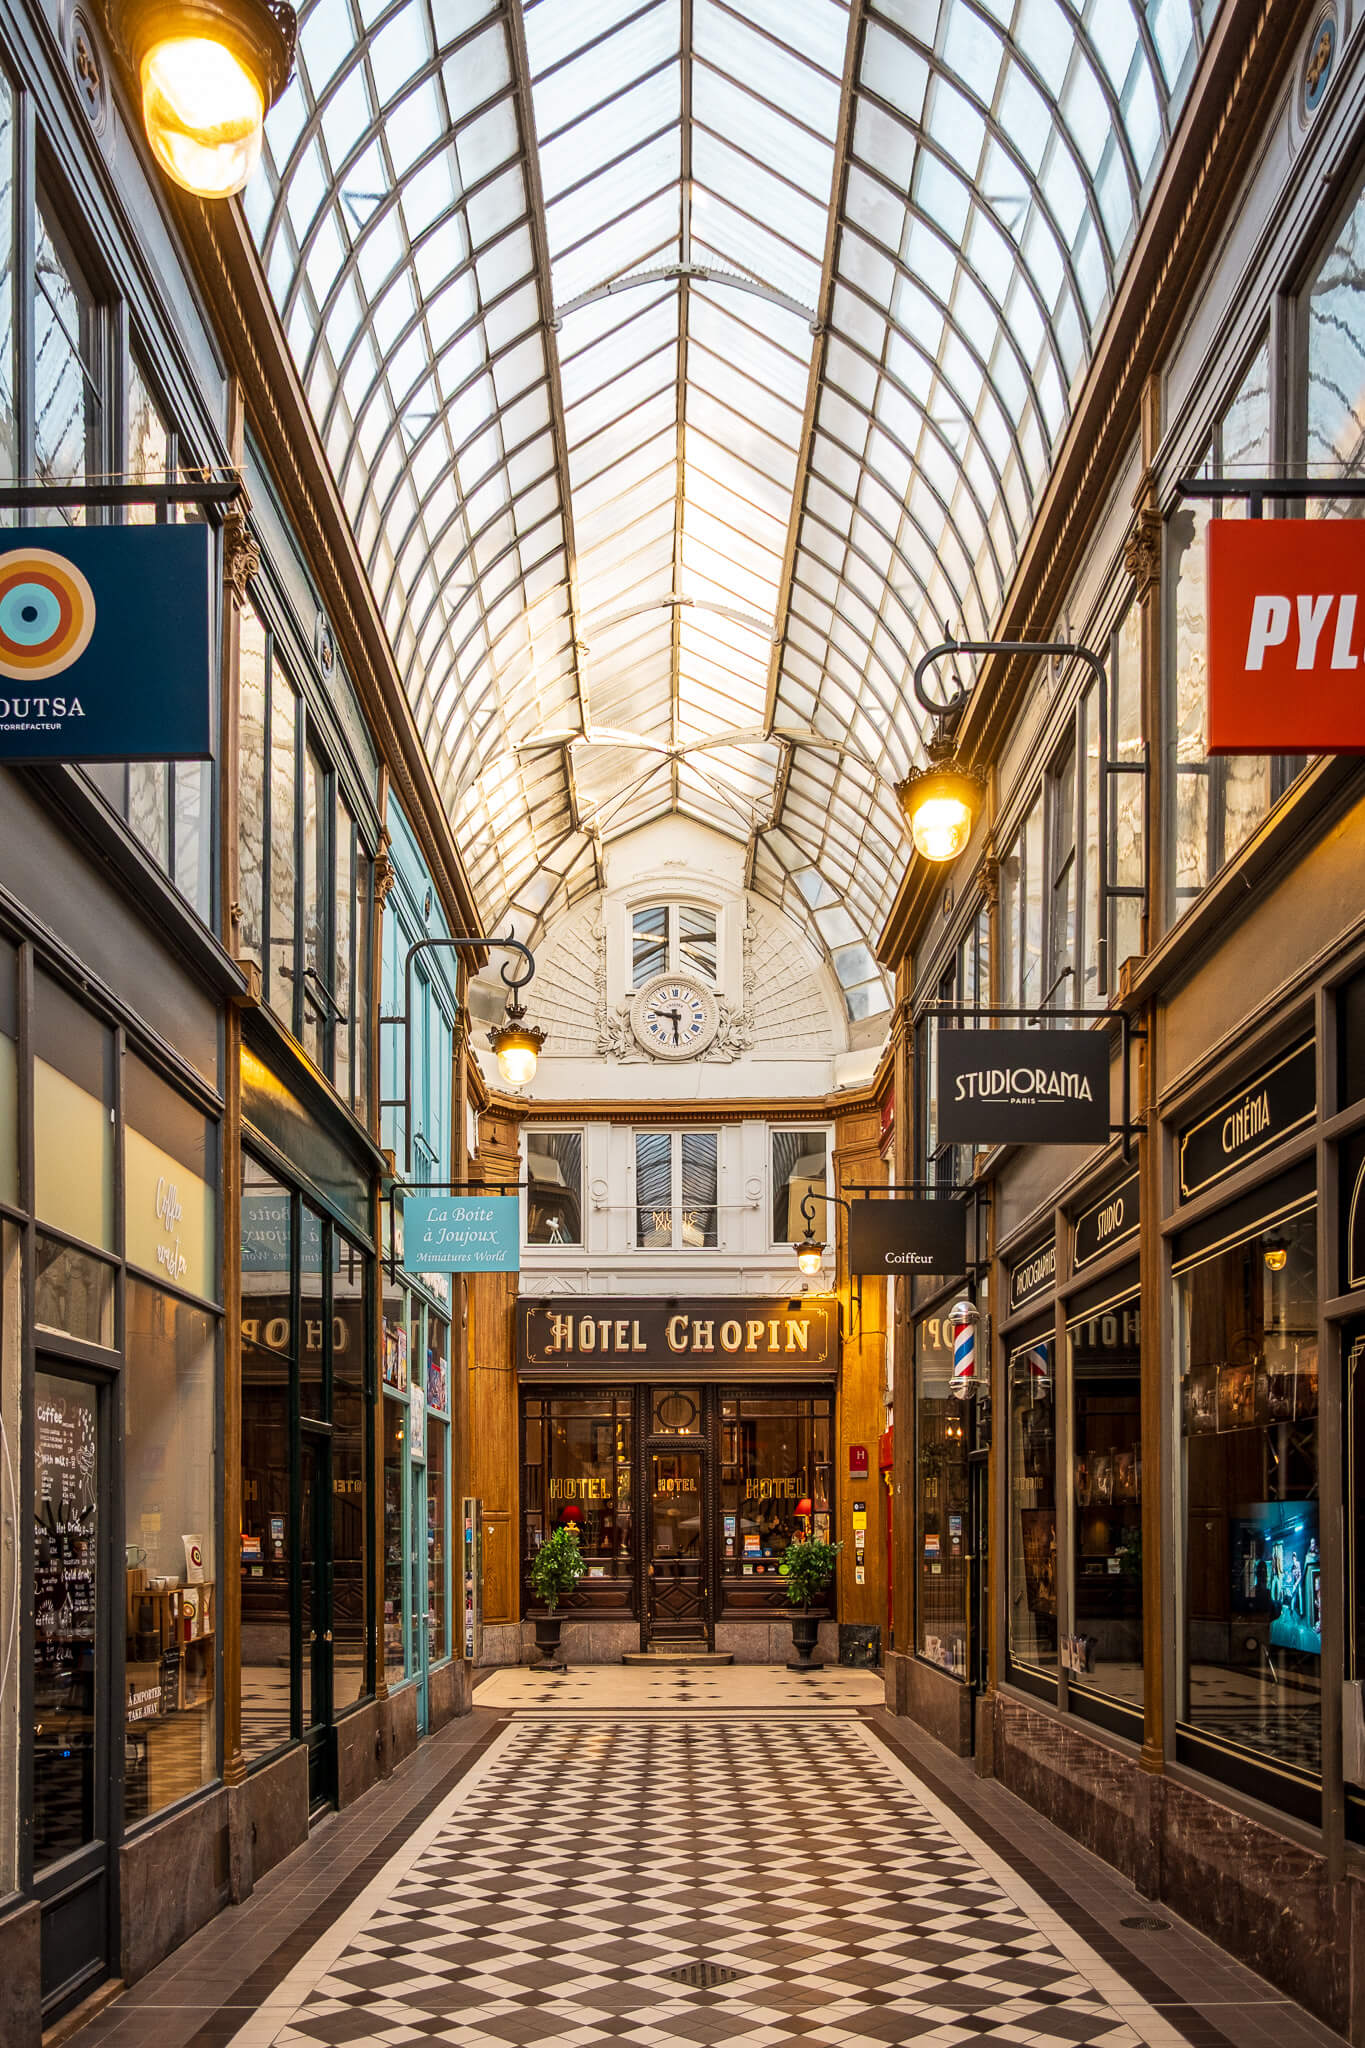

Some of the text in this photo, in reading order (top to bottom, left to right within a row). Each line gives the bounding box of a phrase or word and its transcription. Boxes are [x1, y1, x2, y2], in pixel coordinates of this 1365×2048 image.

[1245, 595, 1365, 670] PYL
[0, 722, 62, 731] TORRÉFACTEUR
[954, 1068, 1094, 1102] STUDIORAMA
[1222, 1089, 1270, 1153] CINÉMA
[424, 1207, 447, 1222] La
[1097, 1198, 1124, 1241] STUDIO
[423, 1226, 500, 1247] à Joujoux
[416, 1250, 508, 1262] Miniatures World
[885, 1252, 933, 1264] Coiffeur
[545, 1311, 647, 1354] HÔTEL
[37, 1406, 63, 1424] Coffee
[550, 1478, 611, 1499] HOTEL
[657, 1478, 697, 1492] HOTEL
[745, 1478, 808, 1499] HOTEL
[133, 1686, 162, 1705] EMPORTER
[128, 1707, 143, 1722] TAKE
